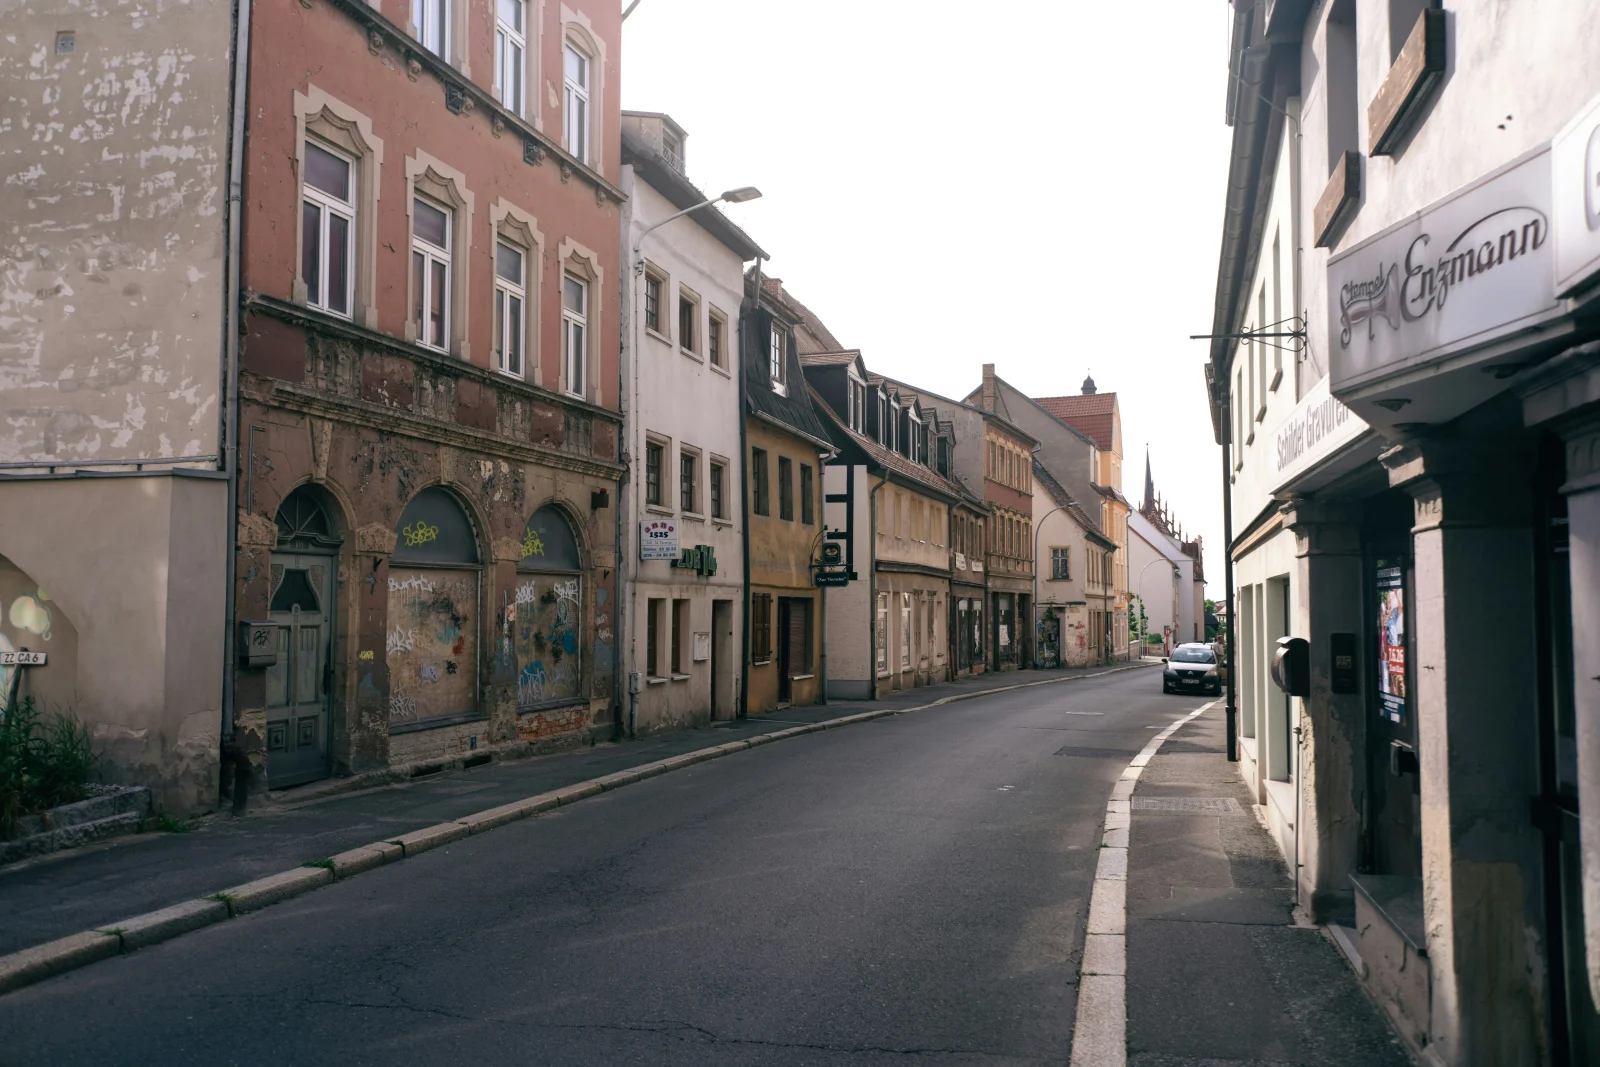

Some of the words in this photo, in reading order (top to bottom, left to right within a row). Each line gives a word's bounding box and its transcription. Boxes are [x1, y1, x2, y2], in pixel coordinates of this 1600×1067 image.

[1400, 208, 1547, 323] Enzmann
[1277, 418, 1304, 472] Schilder
[1306, 395, 1348, 449] Gravuren
[644, 521, 674, 533] anno
[649, 531, 669, 539] 1525
[17, 653, 30, 663] CA
[32, 653, 39, 663] 6
